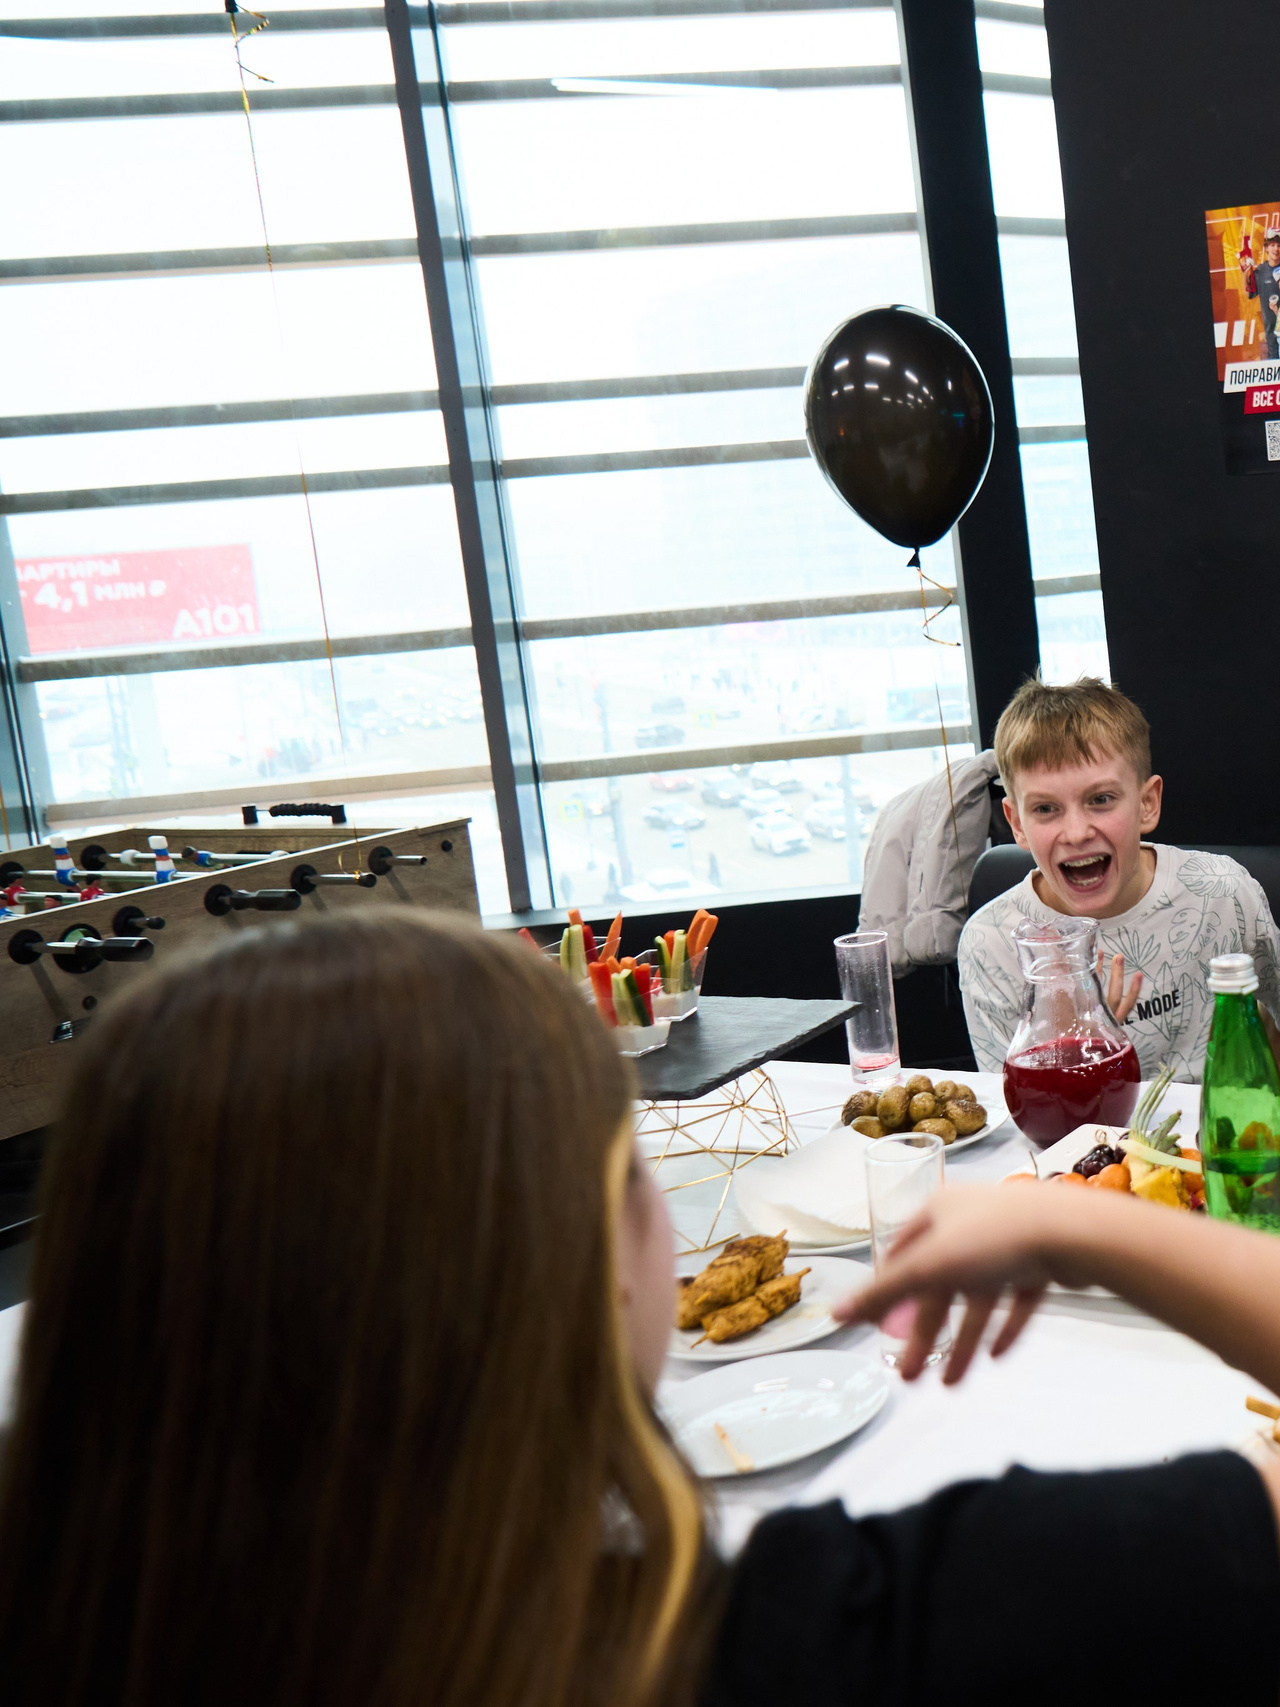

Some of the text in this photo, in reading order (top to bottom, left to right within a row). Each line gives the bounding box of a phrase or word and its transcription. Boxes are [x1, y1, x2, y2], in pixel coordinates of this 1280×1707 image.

[1252, 390, 1275, 408] ВСЕ
[17, 560, 120, 582] АРТИРЫ
[34, 581, 89, 612] 4,1
[1137, 990, 1181, 1020] MODE
